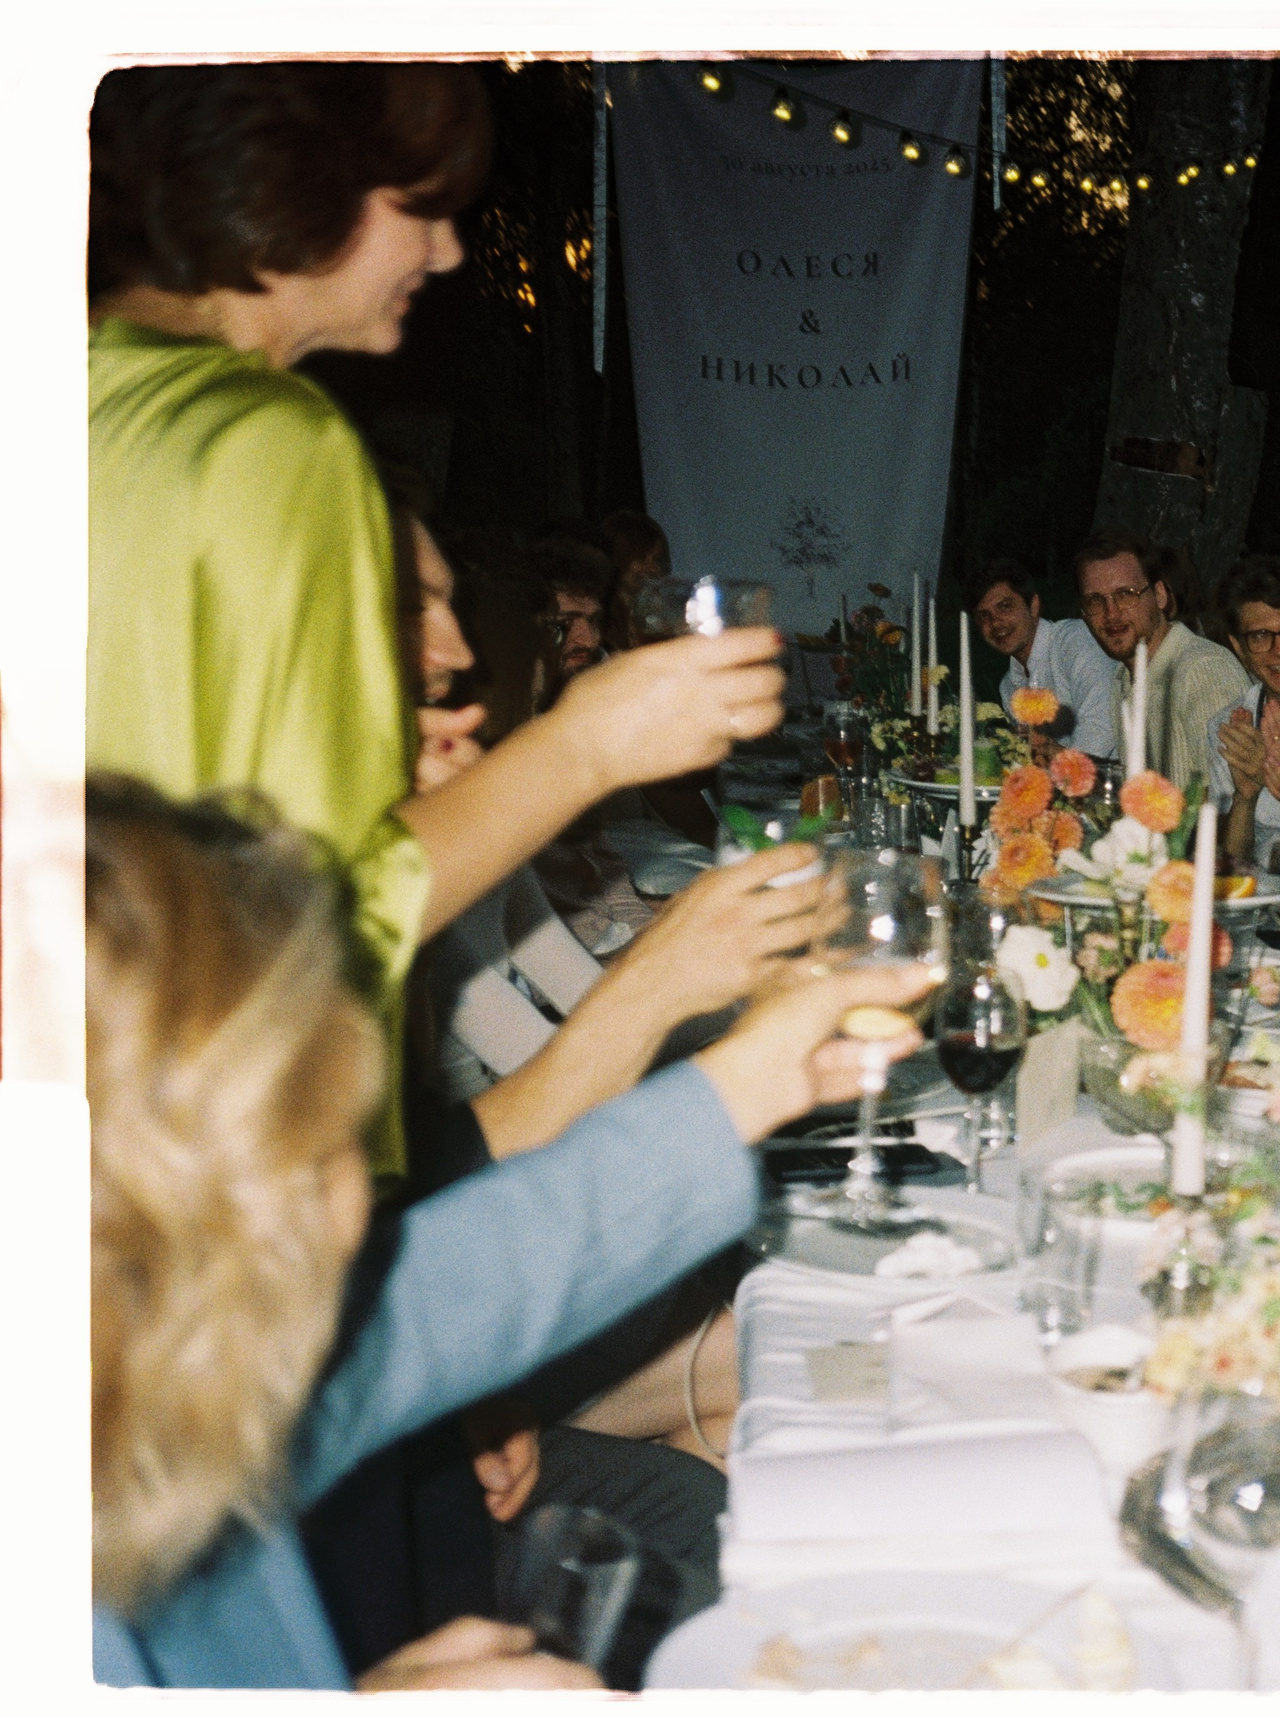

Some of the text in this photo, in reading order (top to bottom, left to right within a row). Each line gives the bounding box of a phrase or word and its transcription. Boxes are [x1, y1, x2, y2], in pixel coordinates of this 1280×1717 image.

[843, 156, 892, 175] 2025
[736, 250, 878, 278] ОЛЕСЯ
[799, 309, 821, 334] &
[701, 353, 911, 388] НИКОЛАЙ
